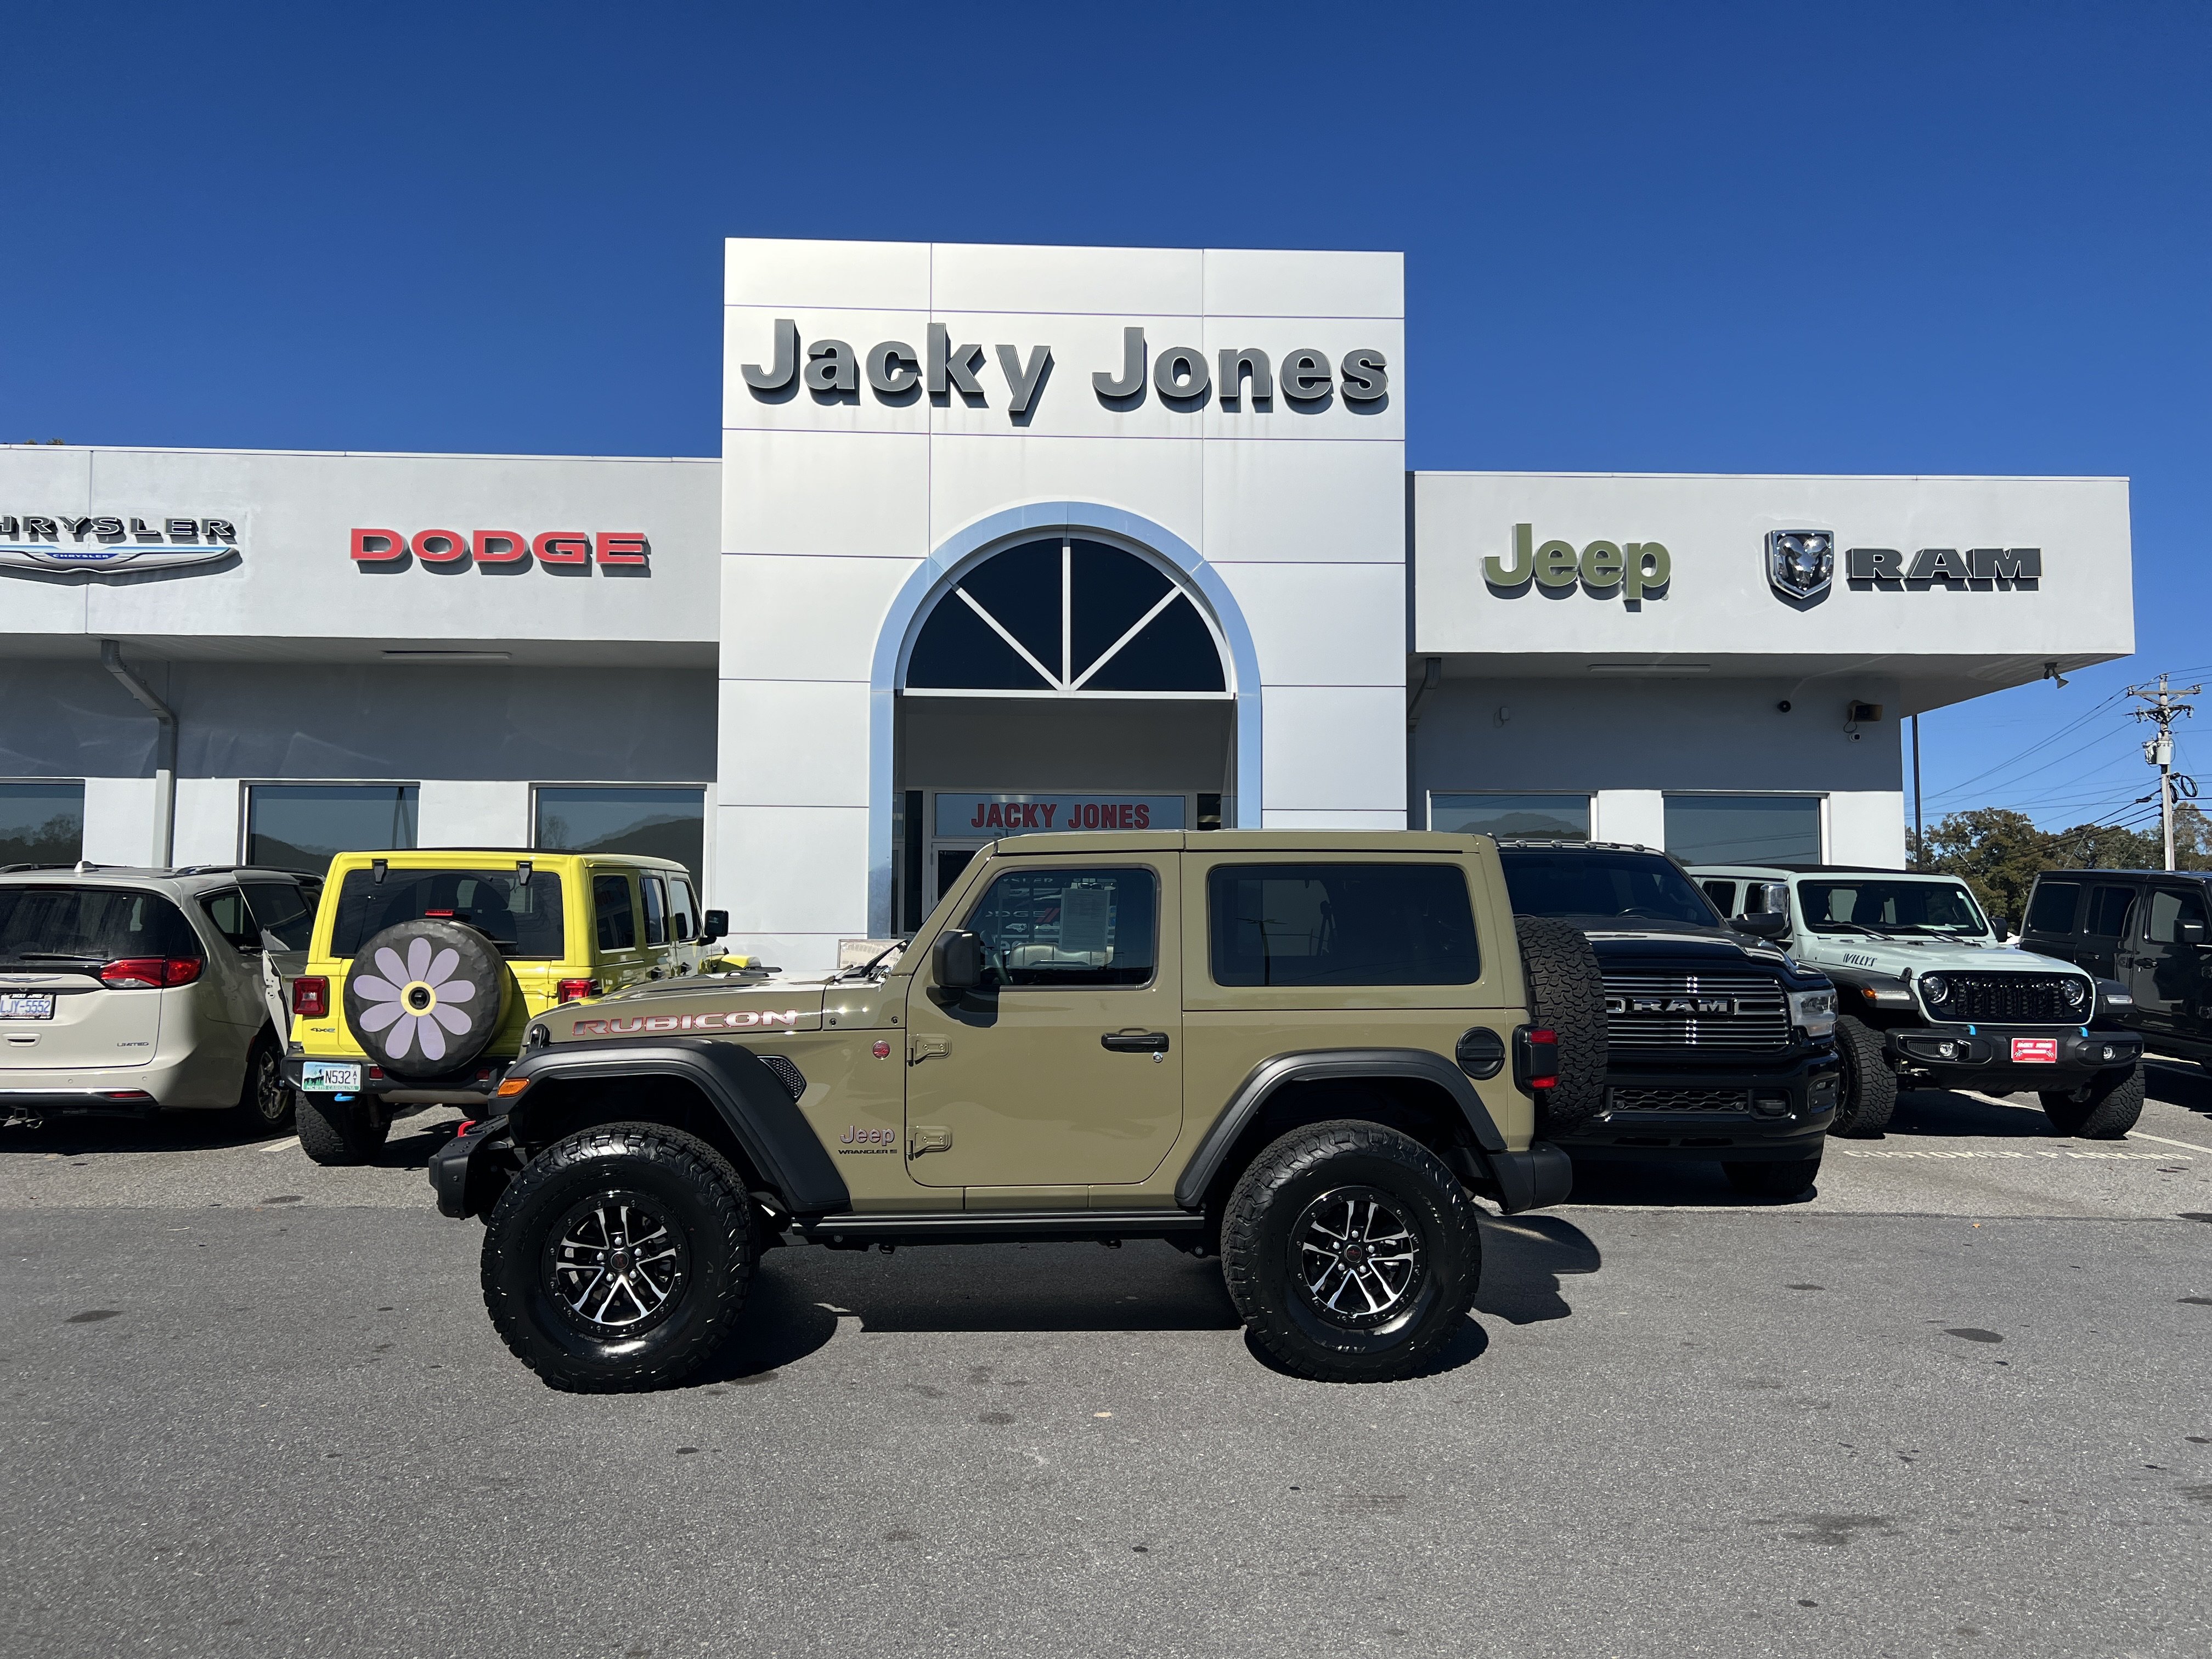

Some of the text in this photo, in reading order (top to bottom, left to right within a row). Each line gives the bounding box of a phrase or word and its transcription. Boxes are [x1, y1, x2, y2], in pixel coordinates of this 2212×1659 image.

[741, 318, 1389, 415] Jacky Jones
[350, 528, 648, 566] DODGE
[1482, 523, 1672, 600] Jeep
[1847, 548, 2043, 580] RAM
[970, 803, 1150, 829] JACKY JONES
[0, 1000, 50, 1013] LJY-5552
[1633, 997, 1728, 1012] RAM
[572, 1009, 797, 1036] RUBICON
[325, 1070, 351, 1084] N532
[839, 1125, 895, 1146] Jeep
[1843, 1150, 2032, 1159] CUSTOMER
